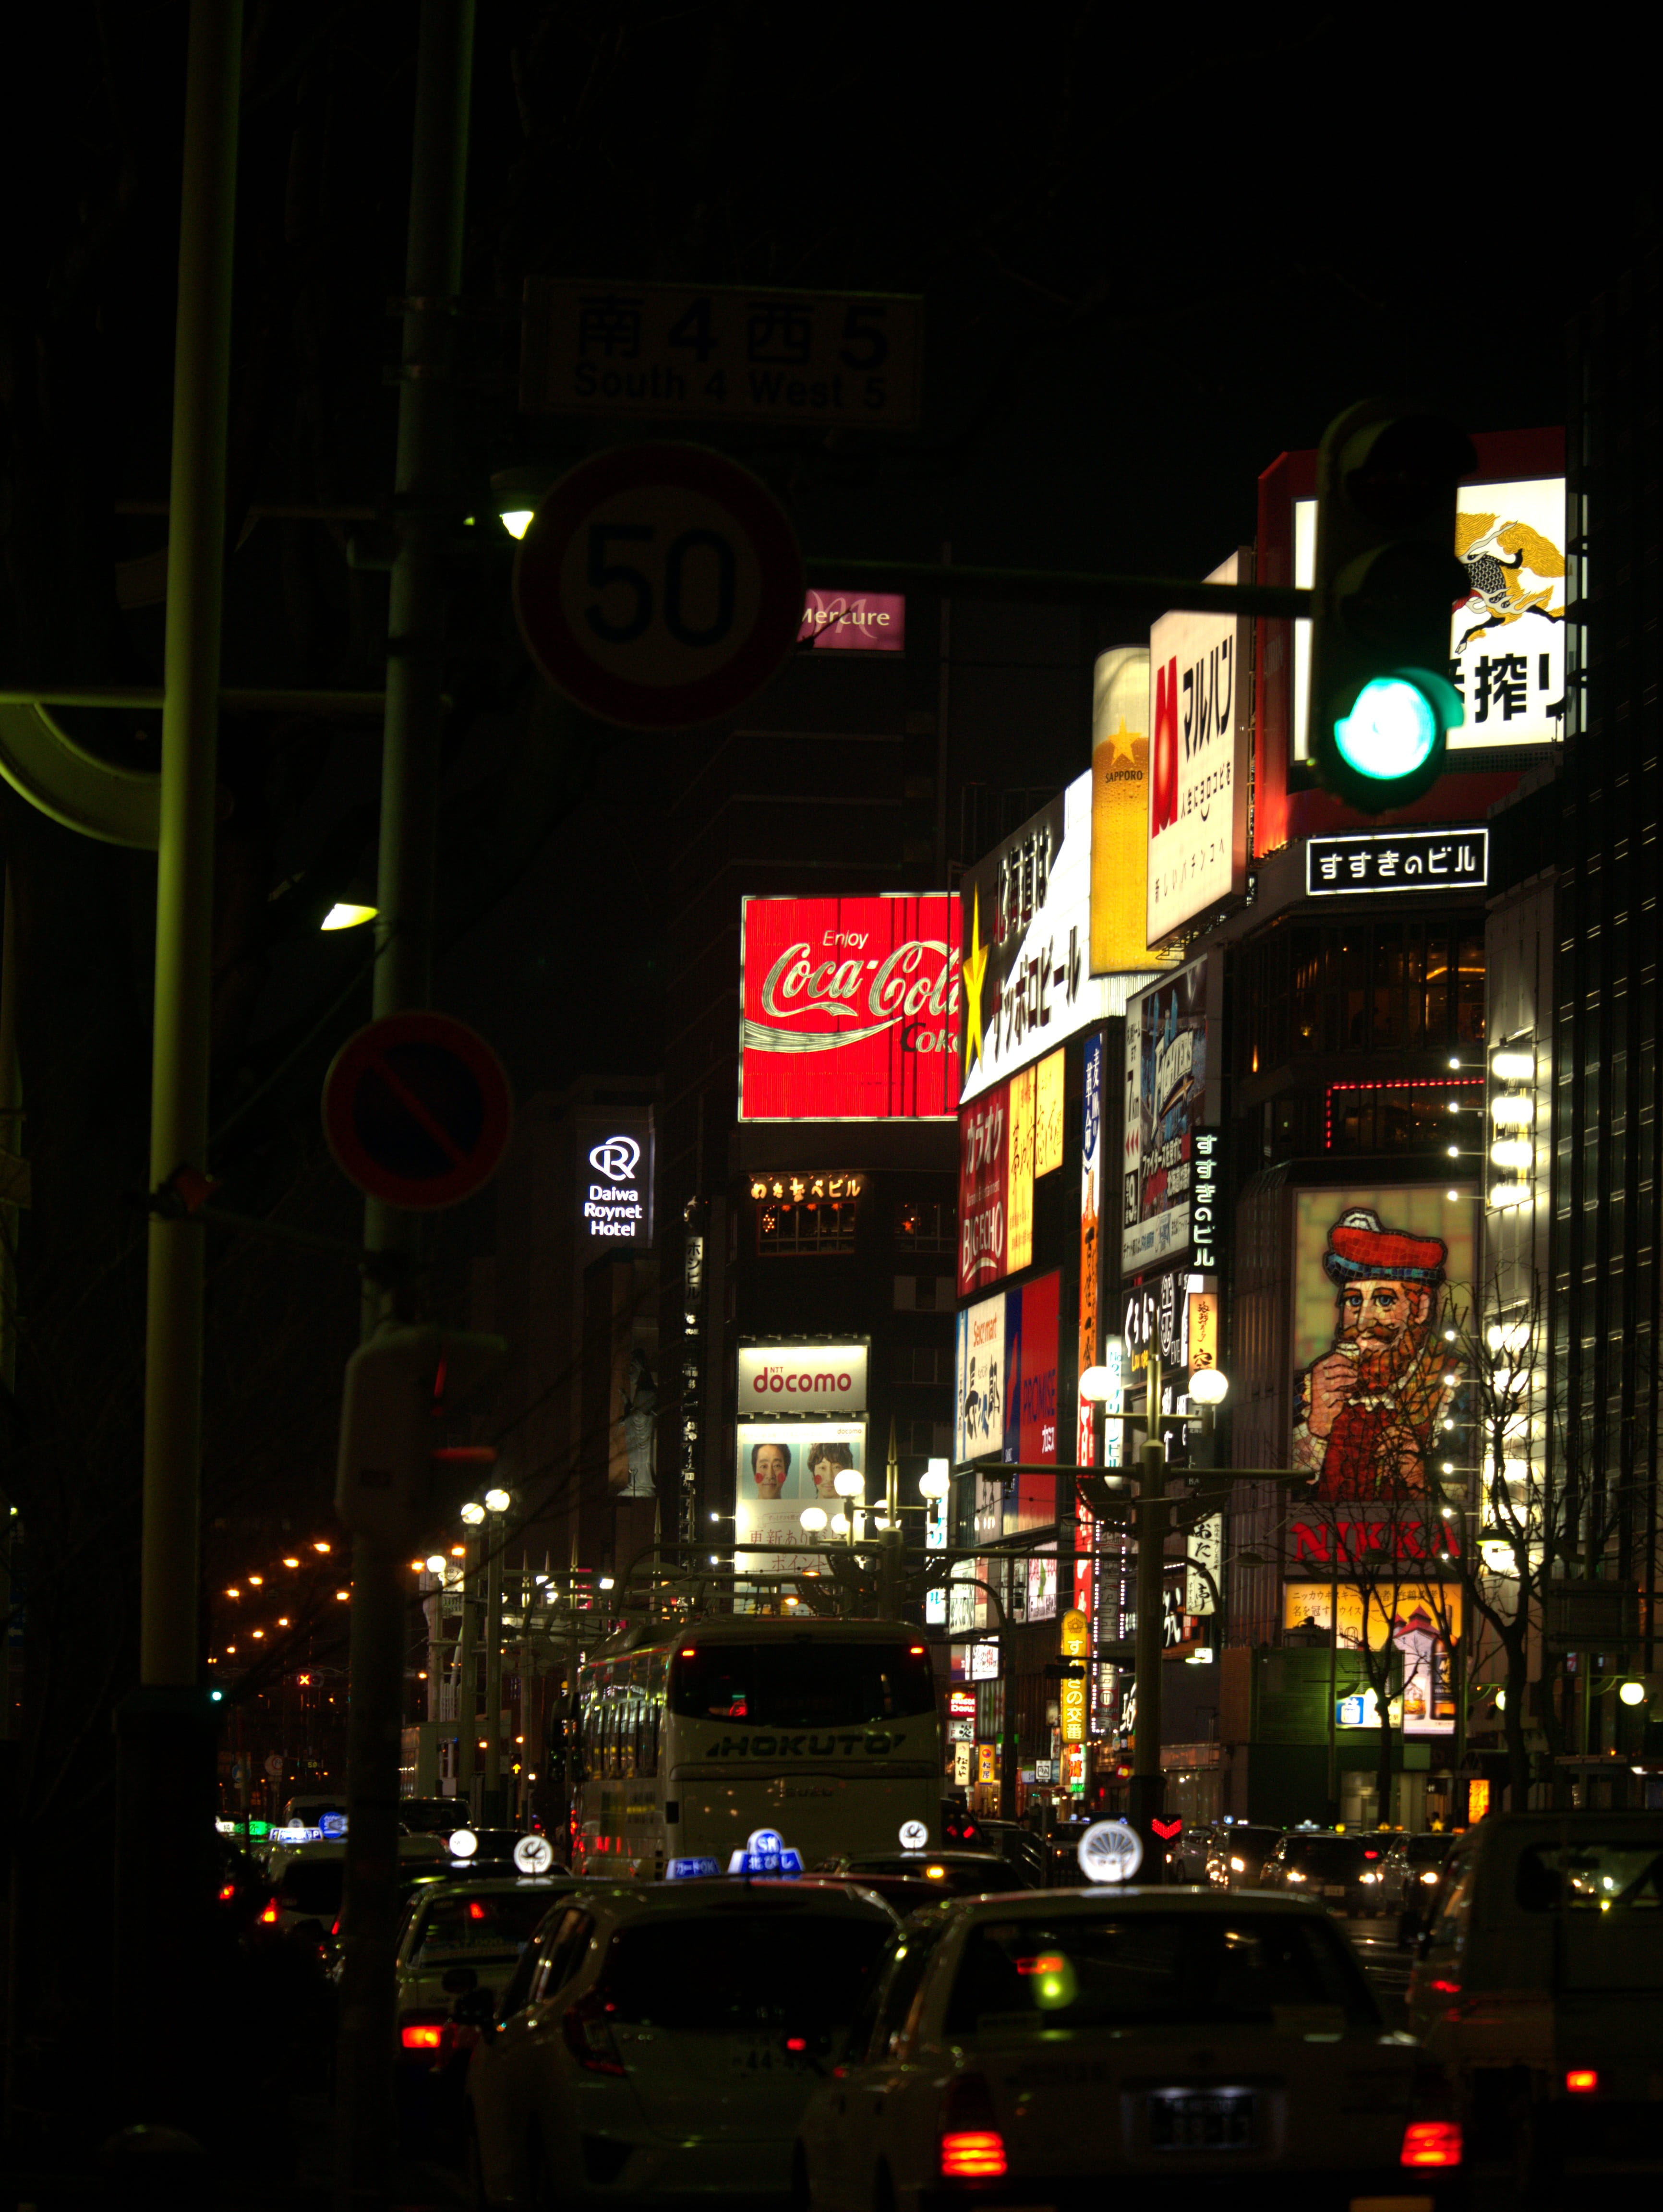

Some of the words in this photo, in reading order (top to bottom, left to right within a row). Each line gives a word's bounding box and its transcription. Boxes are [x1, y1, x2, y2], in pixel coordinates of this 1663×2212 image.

[575, 363, 685, 399] South
[706, 369, 727, 399] 4
[749, 371, 843, 408] West
[863, 377, 886, 409] 5
[585, 523, 735, 647] 50
[799, 606, 890, 626] Mercure
[1105, 769, 1143, 784] SAPPORO
[1181, 760, 1230, 819] 人生にヨロコビを
[1320, 845, 1477, 879] すすきのビル
[822, 930, 868, 949] Enjoy
[991, 926, 1082, 1063] サッポロビール
[965, 1104, 1003, 1176] カラオケ
[590, 1186, 639, 1202] Daiwa
[750, 1178, 861, 1202] わたなべビル
[1194, 1135, 1217, 1267] すすきのビル
[584, 1202, 642, 1220] Roynet
[591, 1221, 635, 1237] Hotel
[686, 1241, 701, 1301] ホシビル
[753, 1368, 851, 1393] docomo
[1023, 1368, 1056, 1425] PROMISE
[1291, 1521, 1461, 1562] NIKKA
[720, 1735, 891, 1755] HOKUTO
